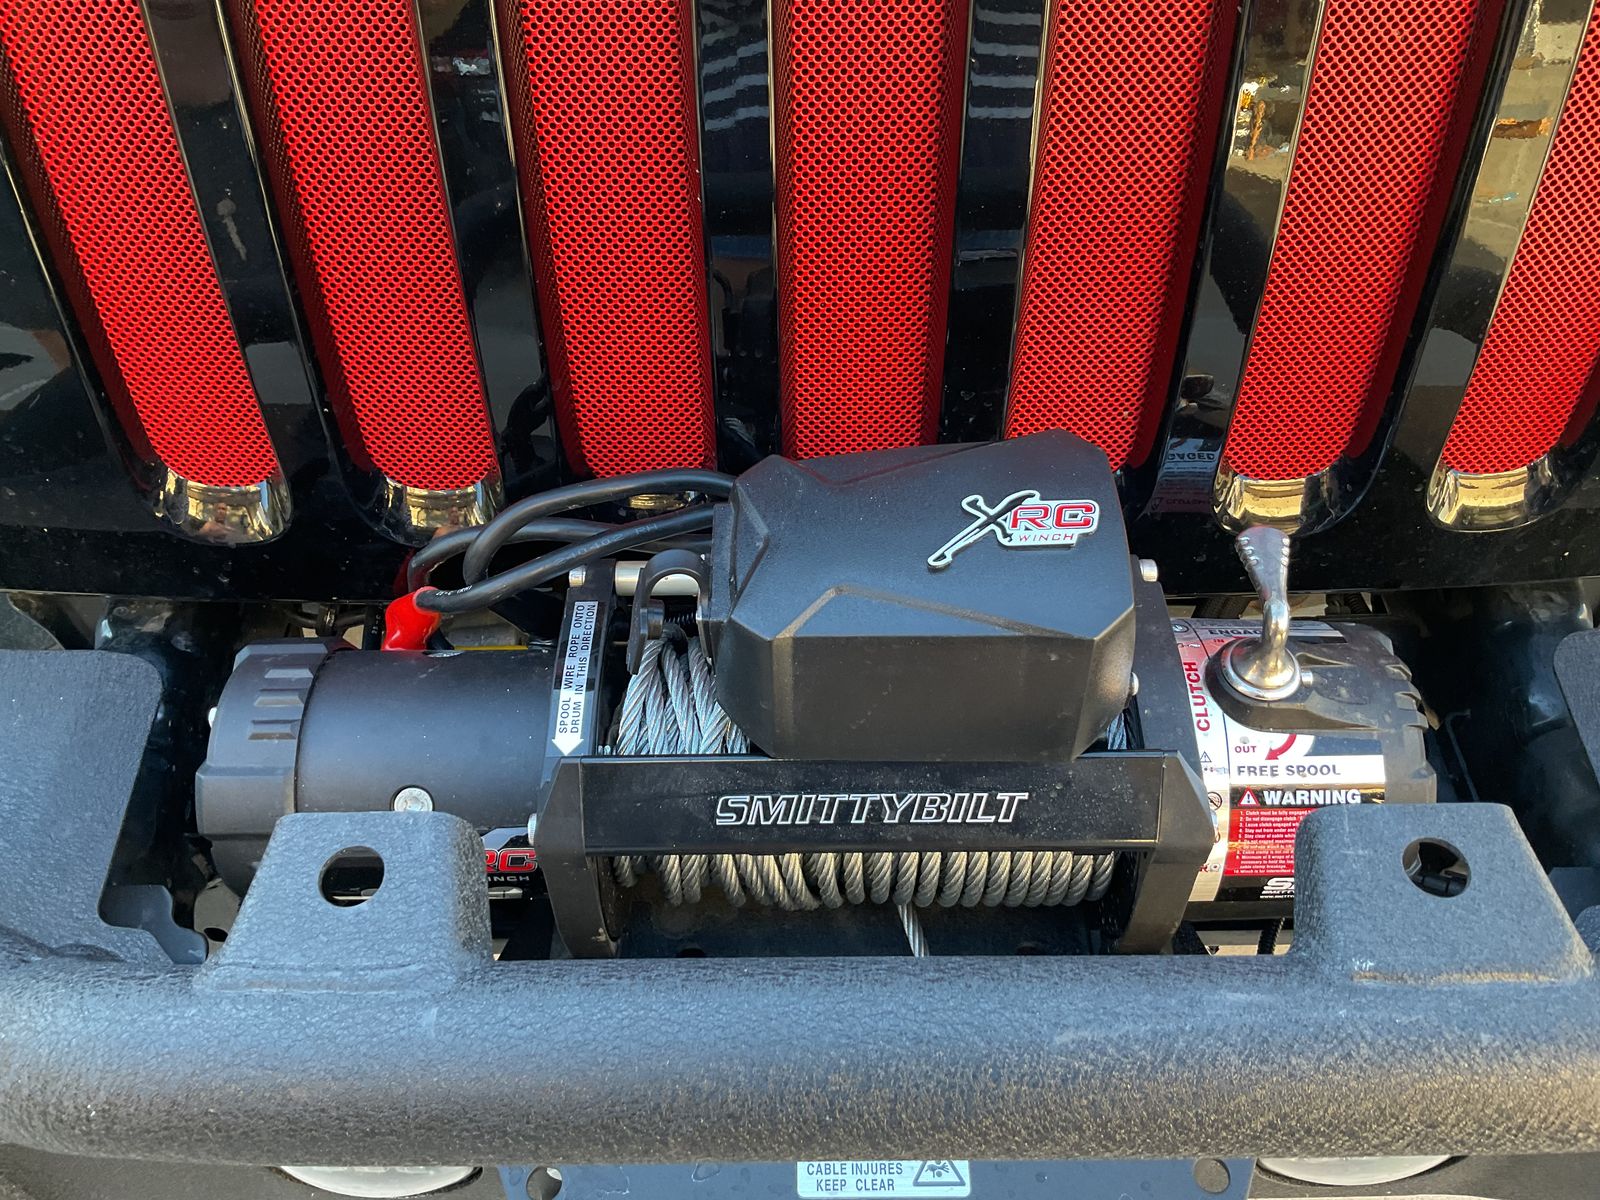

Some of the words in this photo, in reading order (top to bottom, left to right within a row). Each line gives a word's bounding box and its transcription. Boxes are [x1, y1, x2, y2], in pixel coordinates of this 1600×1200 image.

[1018, 532, 1075, 542] WINCH
[574, 604, 585, 628] ONTO
[581, 603, 596, 651] DIRECTION
[568, 634, 580, 658] ROPE
[563, 664, 575, 689] WIRE
[576, 657, 587, 678] THIS
[575, 684, 584, 695] IN
[1183, 662, 1210, 732] CLUTCH
[559, 697, 571, 734] SPOOL
[570, 701, 582, 733] DRUM
[1235, 745, 1257, 753] OUT
[1237, 765, 1279, 777] FREE
[1285, 764, 1341, 776] SPOOL
[1263, 789, 1361, 805] WARNING
[716, 792, 1029, 825] SMITTYBILT
[806, 1163, 847, 1176] CABLE
[851, 1162, 903, 1175] INJURES
[816, 1179, 847, 1192] KEEP
[855, 1178, 895, 1191] CLEAR
